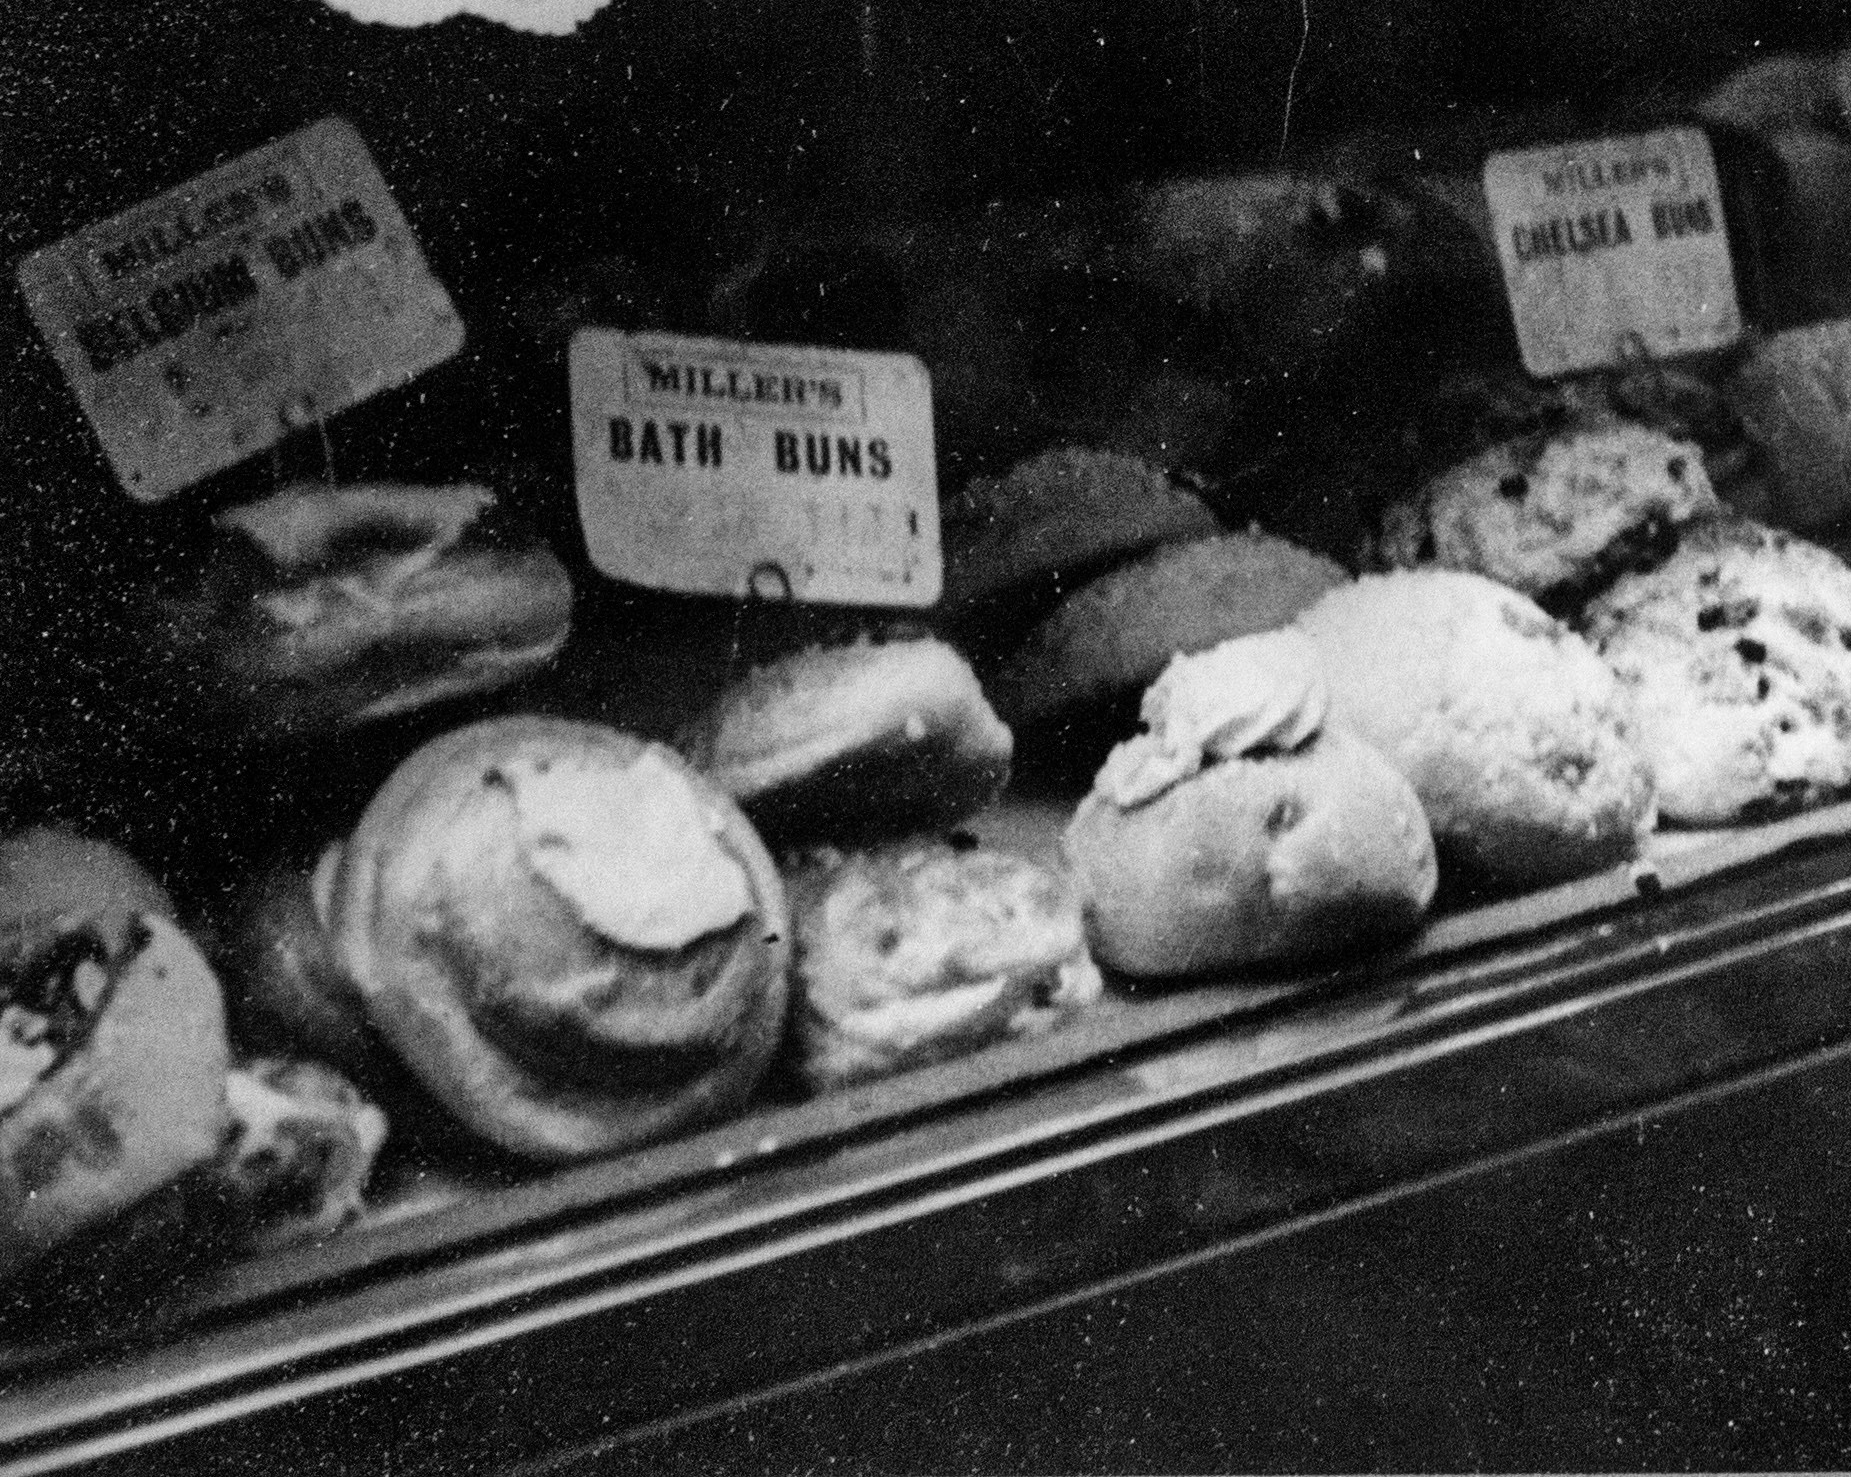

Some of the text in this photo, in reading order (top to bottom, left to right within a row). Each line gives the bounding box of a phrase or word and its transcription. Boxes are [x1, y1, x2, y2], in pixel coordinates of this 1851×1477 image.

[263, 201, 378, 280] BUNS
[1510, 196, 1714, 265] CHELSEA BUNS
[642, 361, 843, 410] MILLER'S
[608, 415, 895, 482] BATH BUNS
